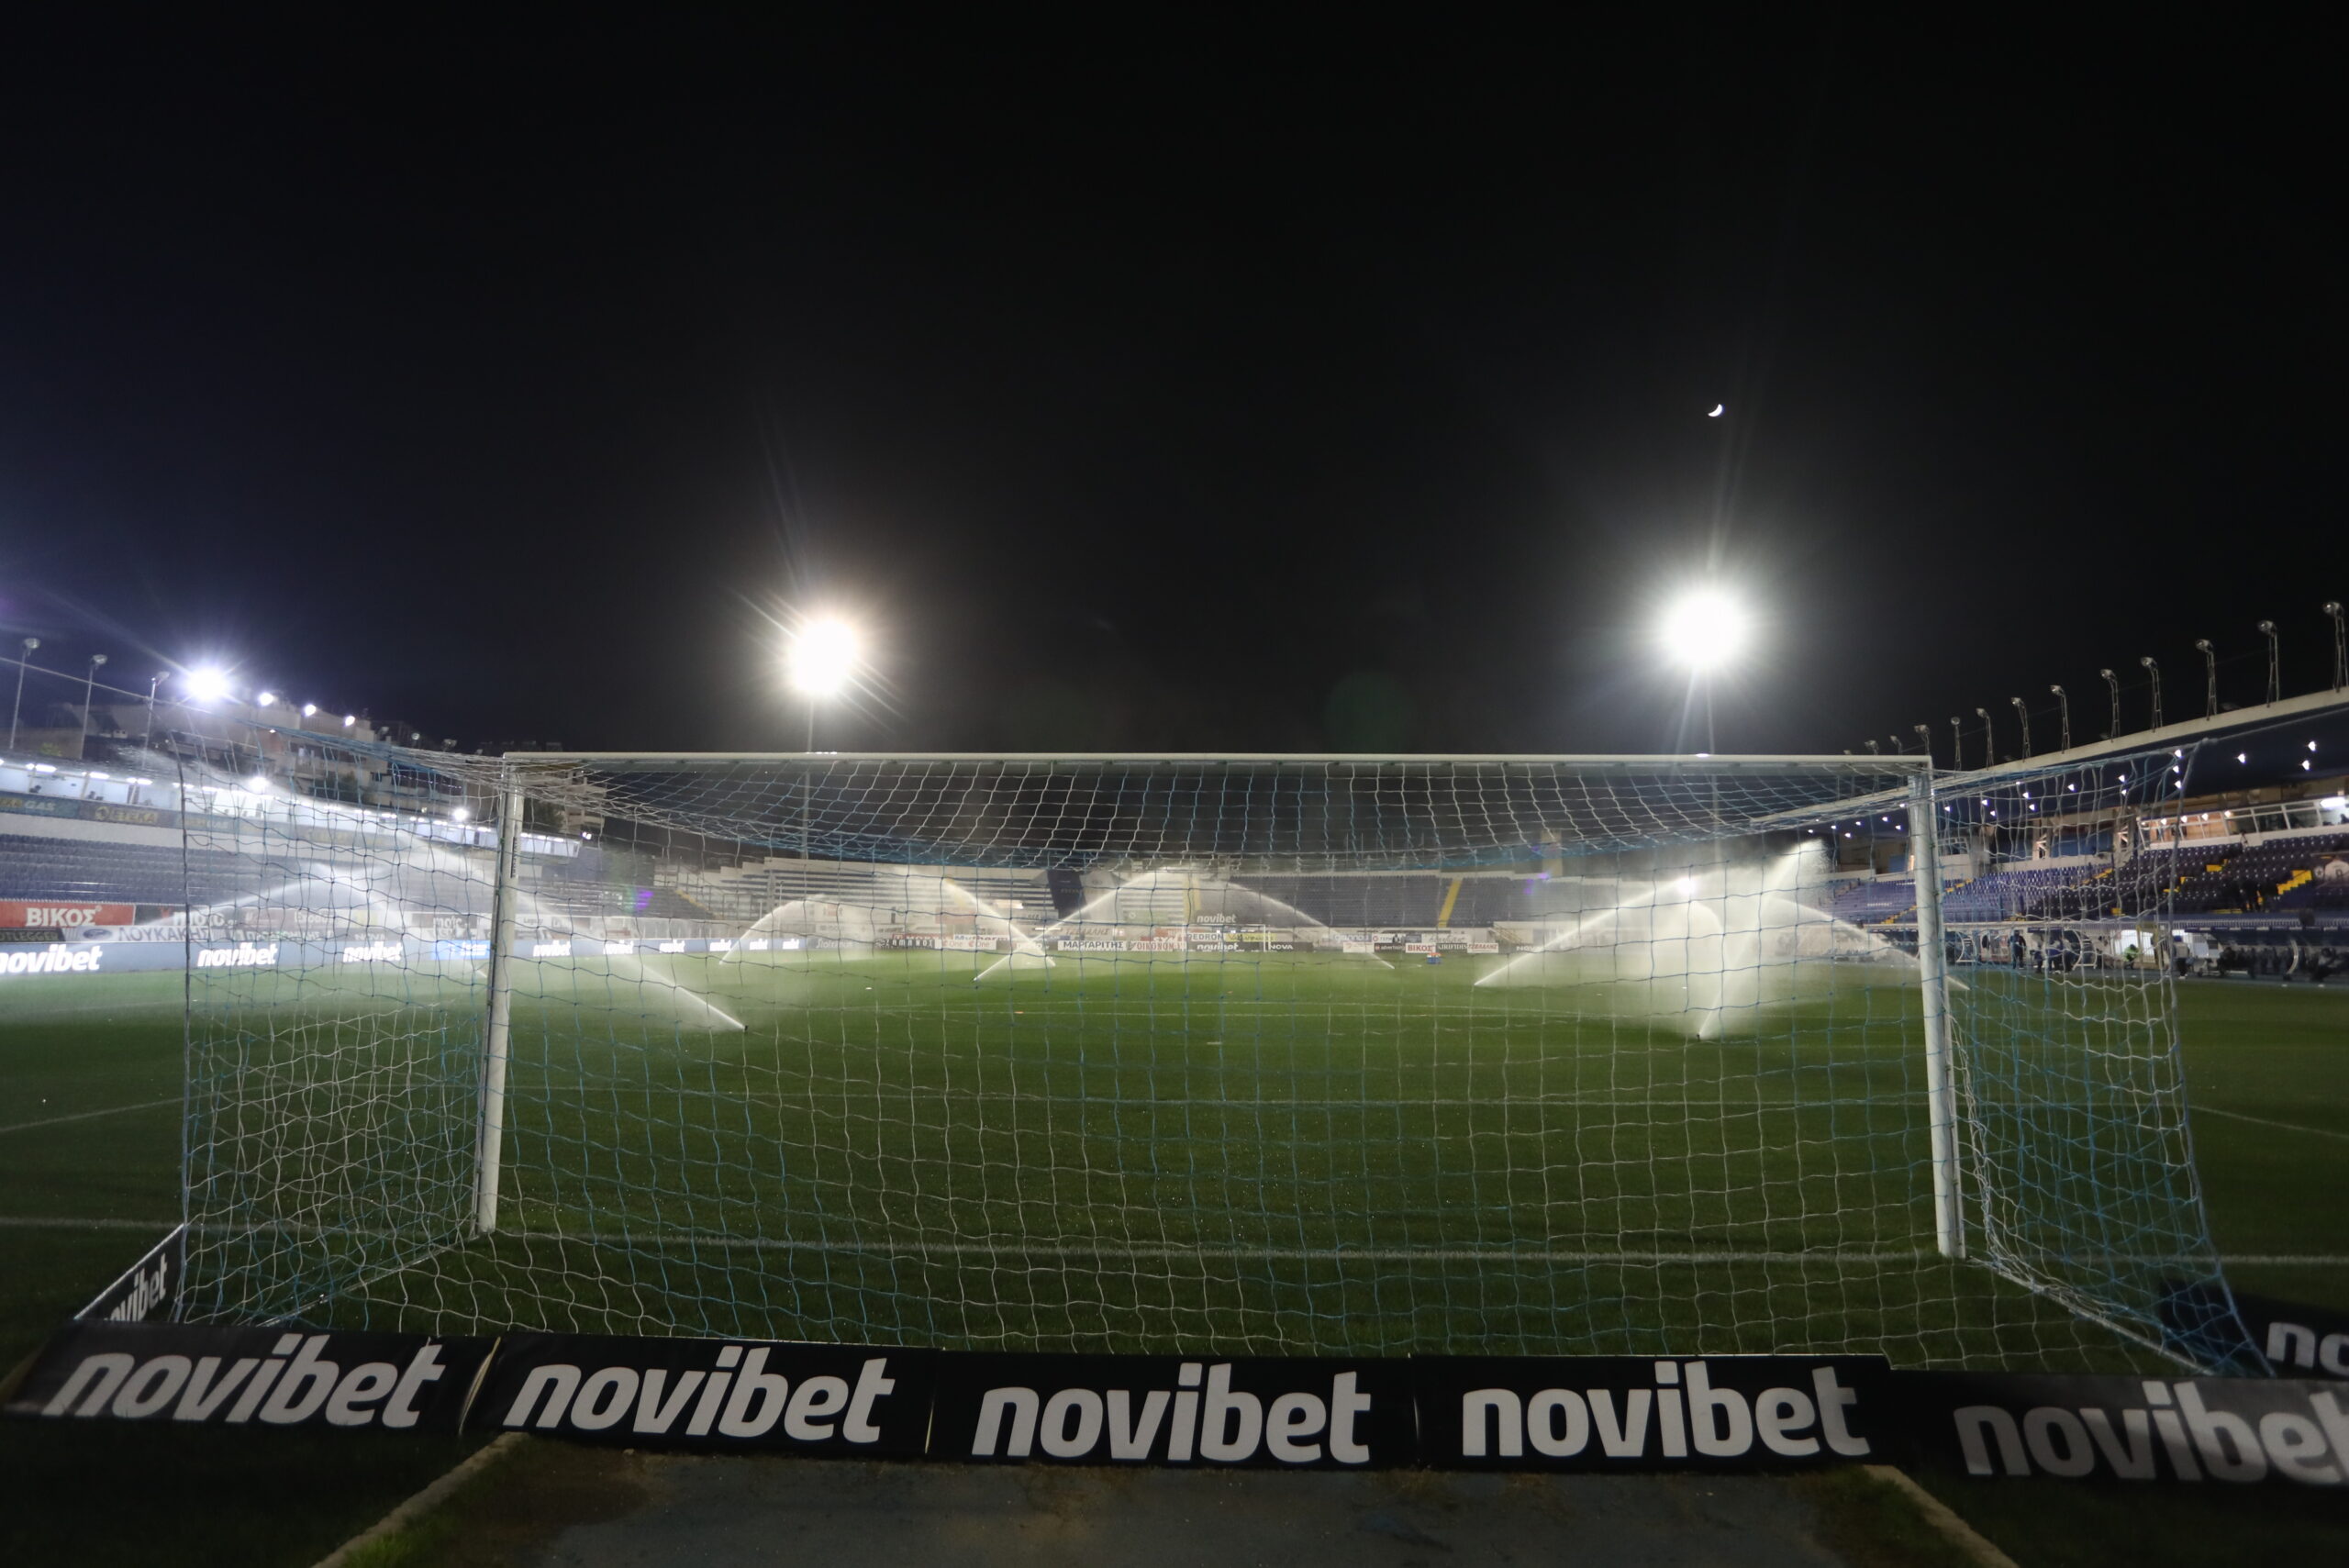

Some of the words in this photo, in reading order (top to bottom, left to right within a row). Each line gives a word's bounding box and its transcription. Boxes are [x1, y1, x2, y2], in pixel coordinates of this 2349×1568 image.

[25, 907, 96, 927] ΒΙΚΟΣ
[197, 942, 278, 967] novibet
[1197, 913, 1237, 923] novibet
[104, 1252, 167, 1322] ovibet
[42, 1333, 444, 1429] novibet
[503, 1345, 896, 1443] novibet
[972, 1362, 1372, 1463] novibet
[1463, 1361, 1871, 1457] novibet
